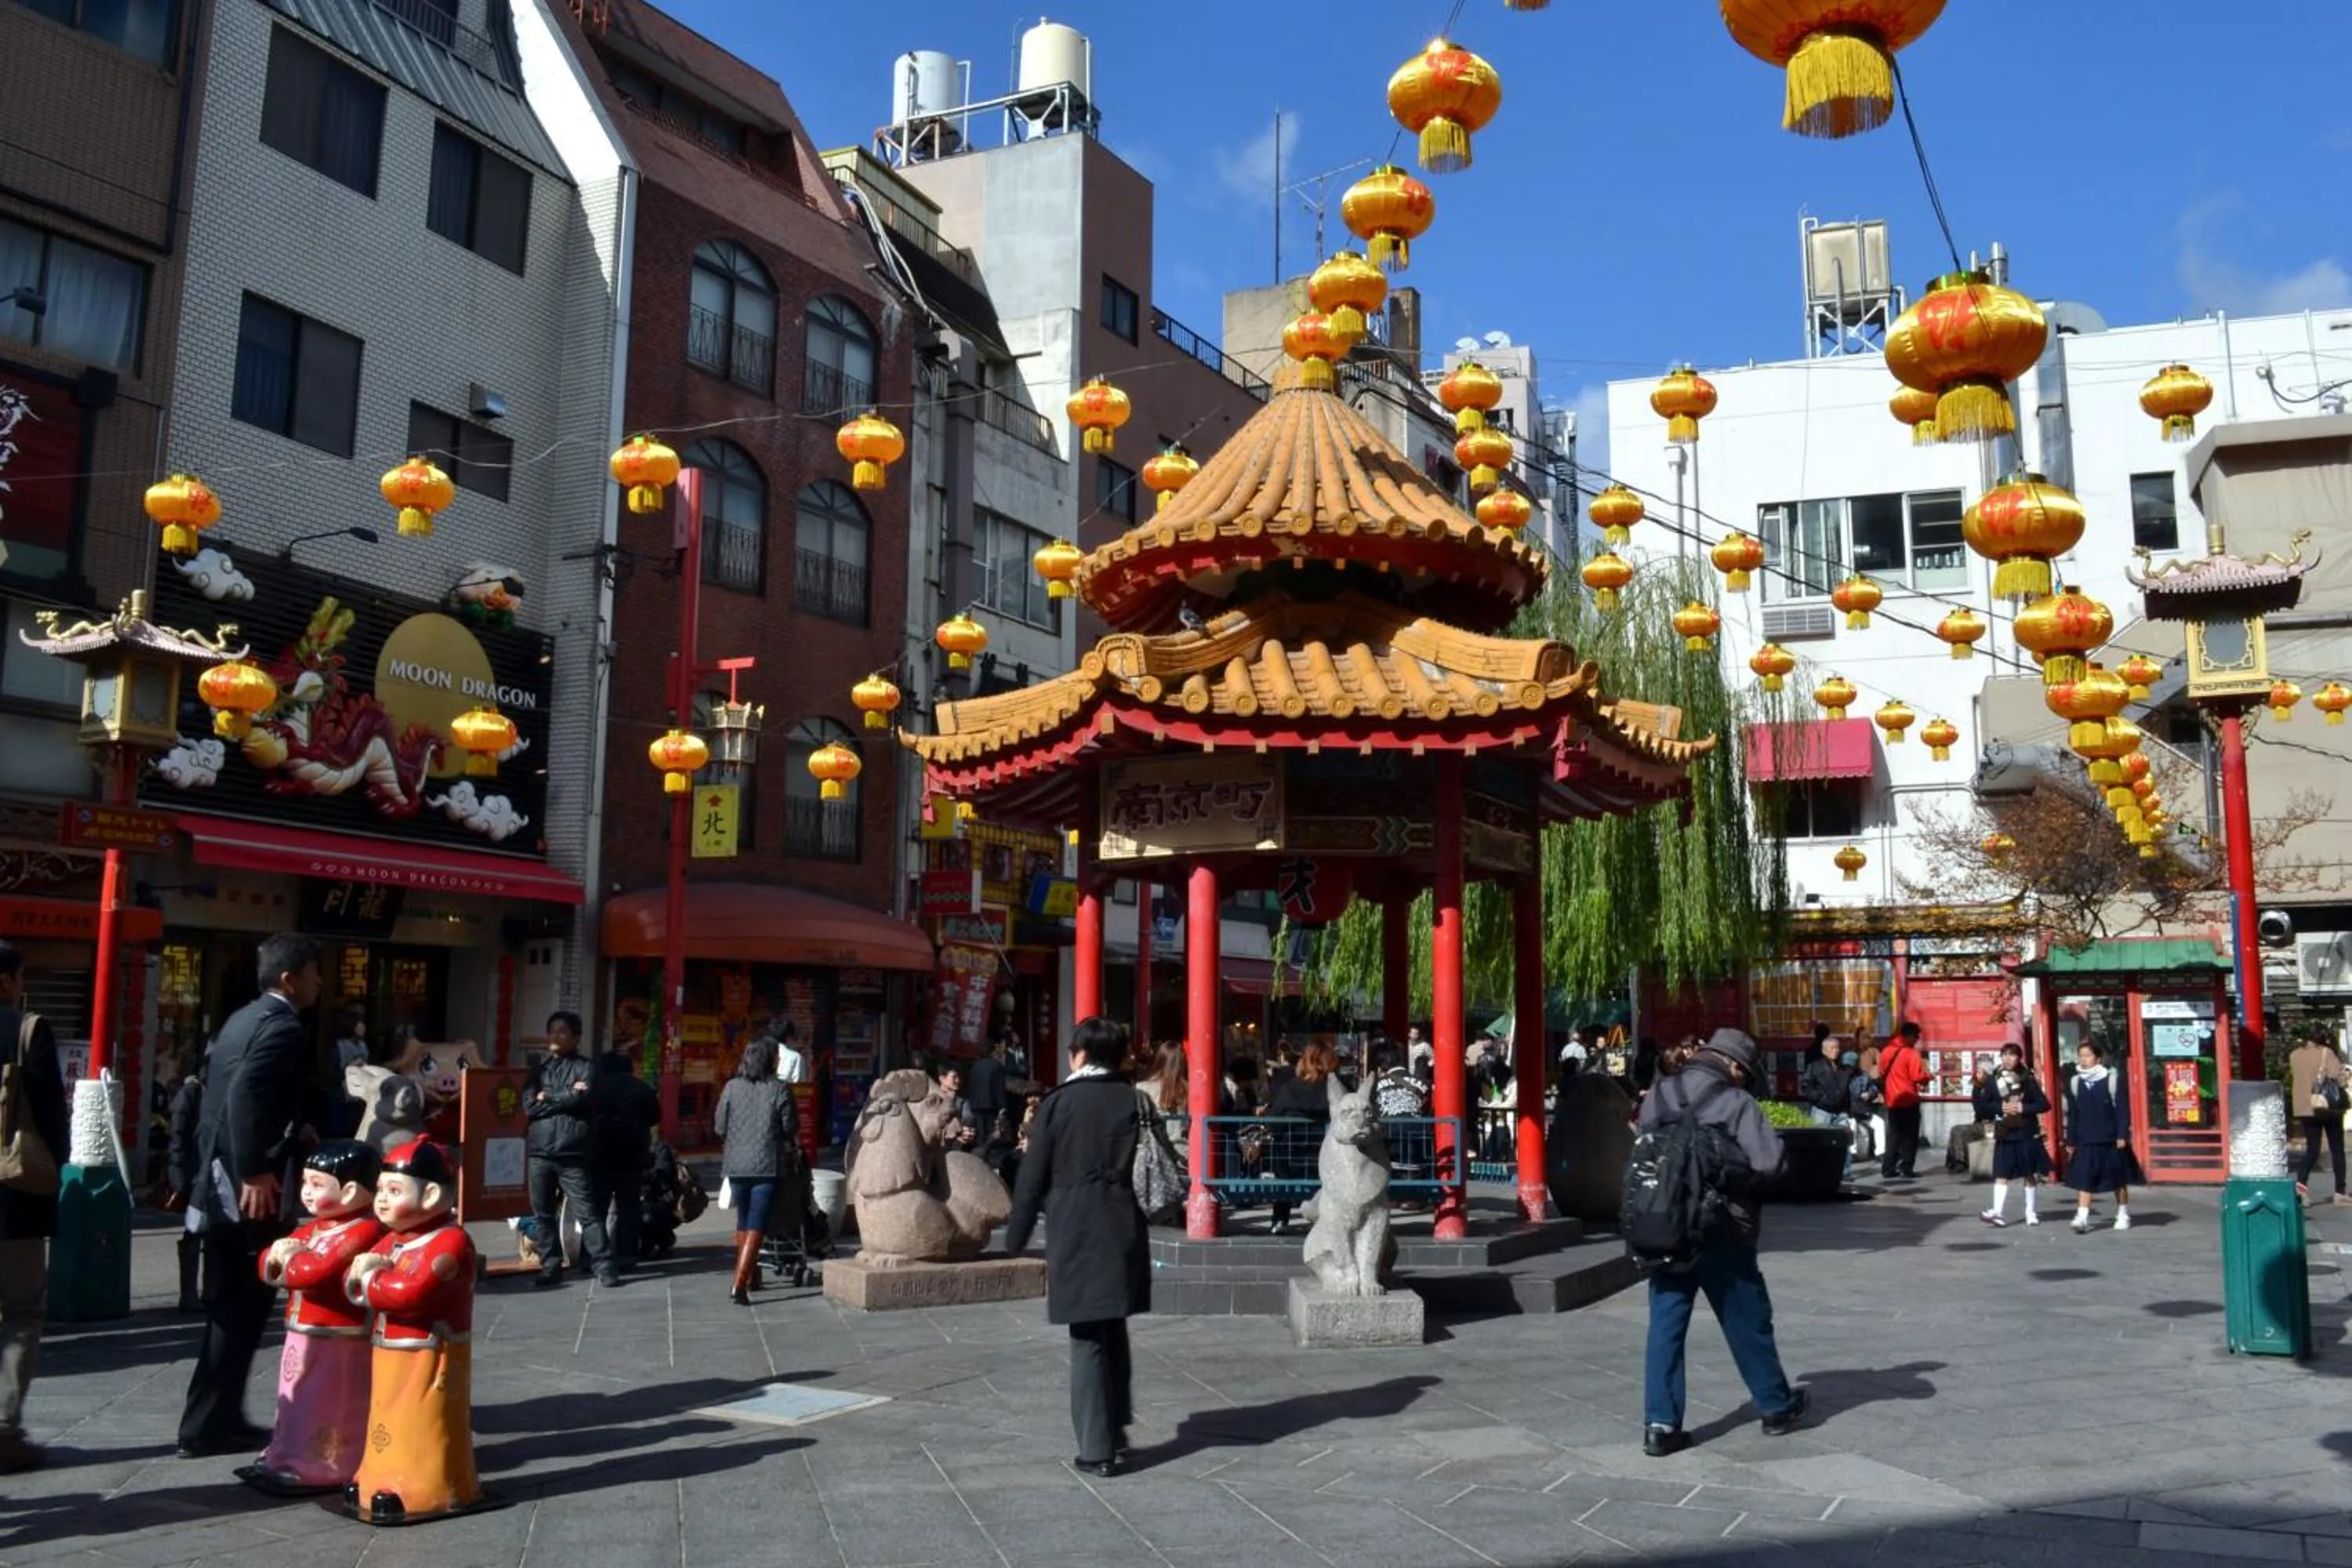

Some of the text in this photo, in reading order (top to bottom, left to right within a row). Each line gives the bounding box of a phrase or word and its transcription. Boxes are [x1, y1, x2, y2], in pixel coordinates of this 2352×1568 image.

[389, 659, 537, 709] MOON DRAGON
[702, 811, 727, 835] 北
[1111, 778, 1273, 833] 南京町
[356, 867, 467, 887] MOON DRAGON
